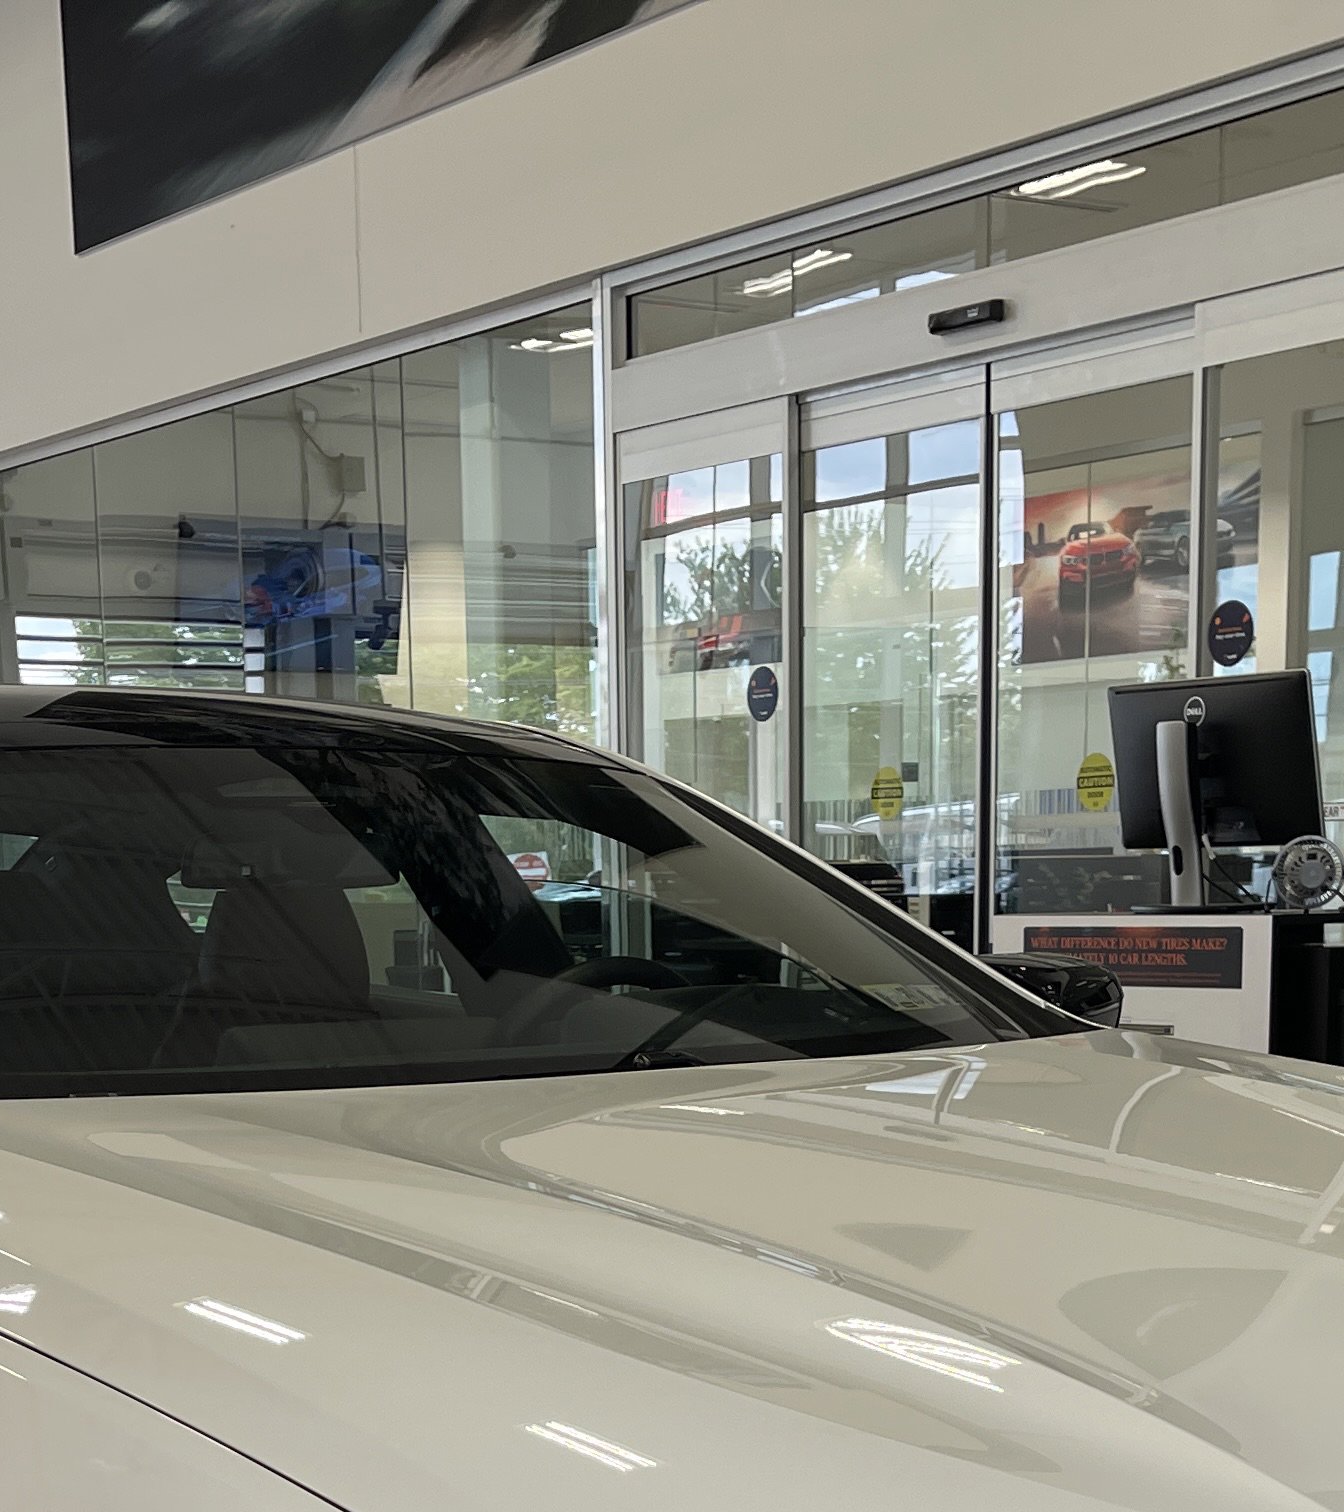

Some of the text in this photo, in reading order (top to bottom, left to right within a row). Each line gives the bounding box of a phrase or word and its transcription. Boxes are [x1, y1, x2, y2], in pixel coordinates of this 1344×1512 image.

[1079, 776, 1113, 788] CAUTION
[1030, 937, 1228, 950] WHAT DIFFERENCE DO NEW TIRES MAKE?
[1119, 953, 1139, 965] CAR
